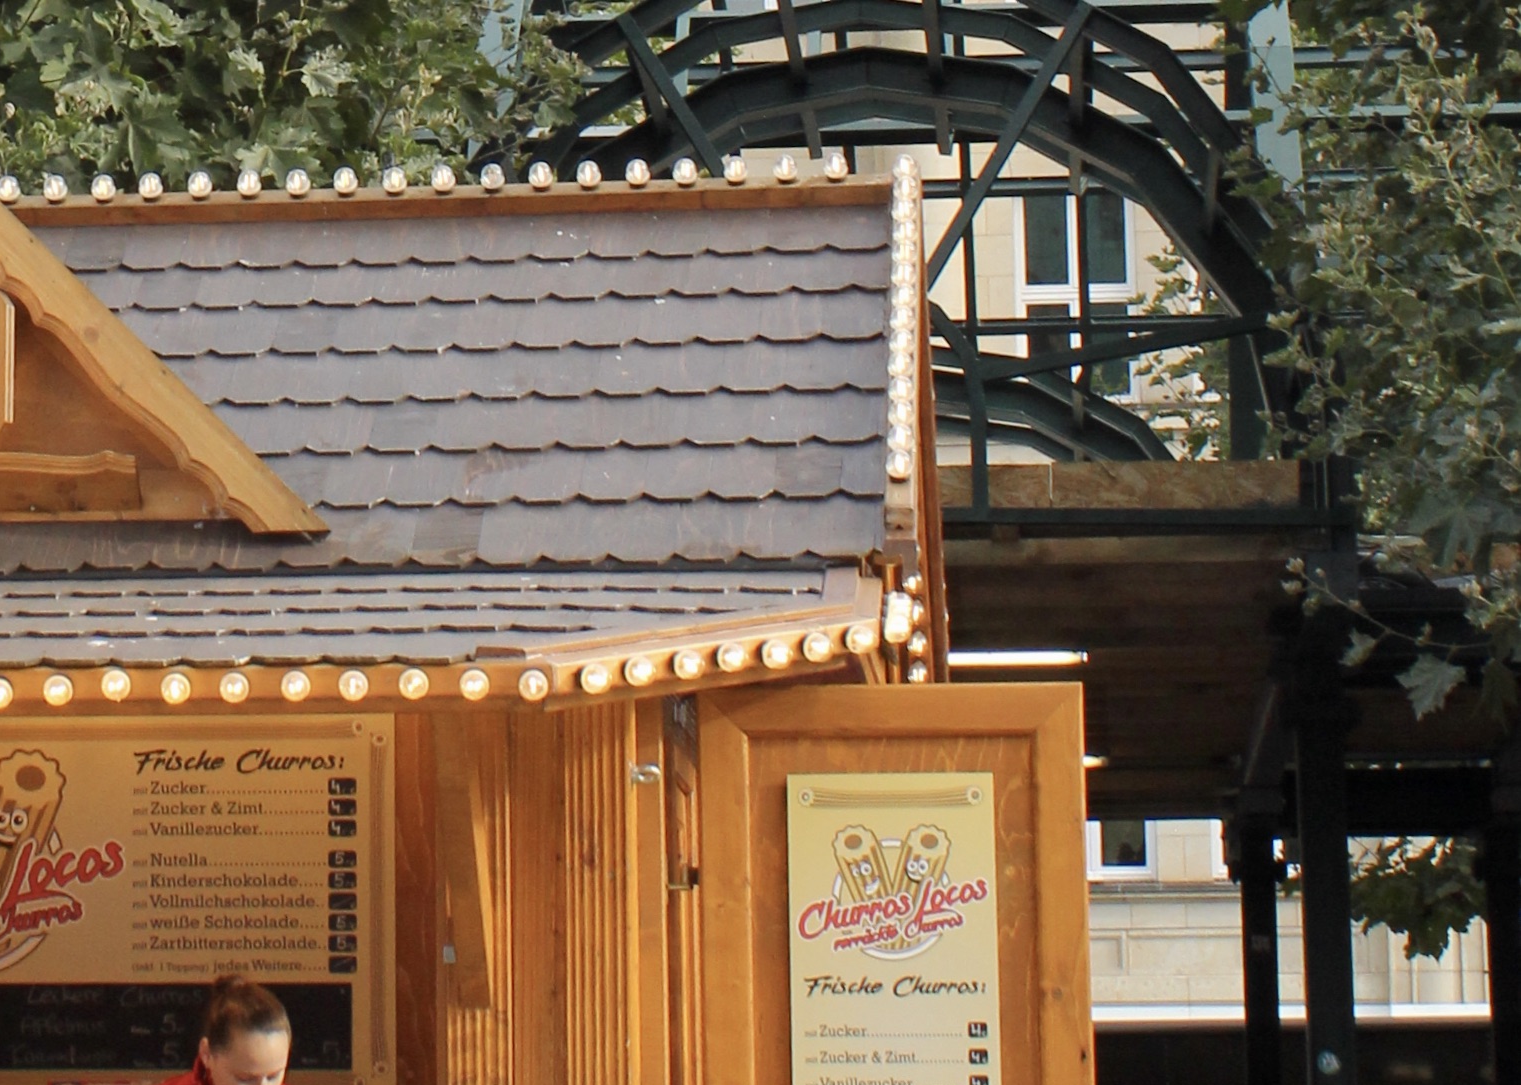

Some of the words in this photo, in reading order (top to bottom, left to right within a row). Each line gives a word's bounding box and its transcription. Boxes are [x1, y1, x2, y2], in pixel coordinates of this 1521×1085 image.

[133, 749, 225, 775] Frische
[235, 748, 345, 775] Churros:
[150, 780, 206, 795] Zucker
[150, 801, 206, 816] Zucker
[210, 801, 223, 816] &
[227, 801, 264, 816] Zimt
[150, 821, 260, 836] Vanillezucker
[150, 853, 207, 867] Nutella
[3, 841, 124, 908] Locos
[150, 873, 299, 888] Kinderschokolade
[149, 894, 316, 909] Vollmilchschokolade
[798, 894, 910, 939] Churros
[913, 879, 988, 925] Locos
[150, 915, 200, 930] weiße
[204, 915, 299, 930] Schokolade
[904, 916, 964, 939] Churros
[150, 936, 317, 951] Zartbitterschokolade
[213, 960, 249, 974] jedes
[251, 960, 303, 972] Weitere
[804, 975, 883, 998] Frische
[892, 975, 986, 998] Churros:
[819, 1024, 868, 1038] Zucker
[819, 1051, 868, 1064] Zucker
[871, 1052, 883, 1064] &
[885, 1051, 918, 1064] Zimt
